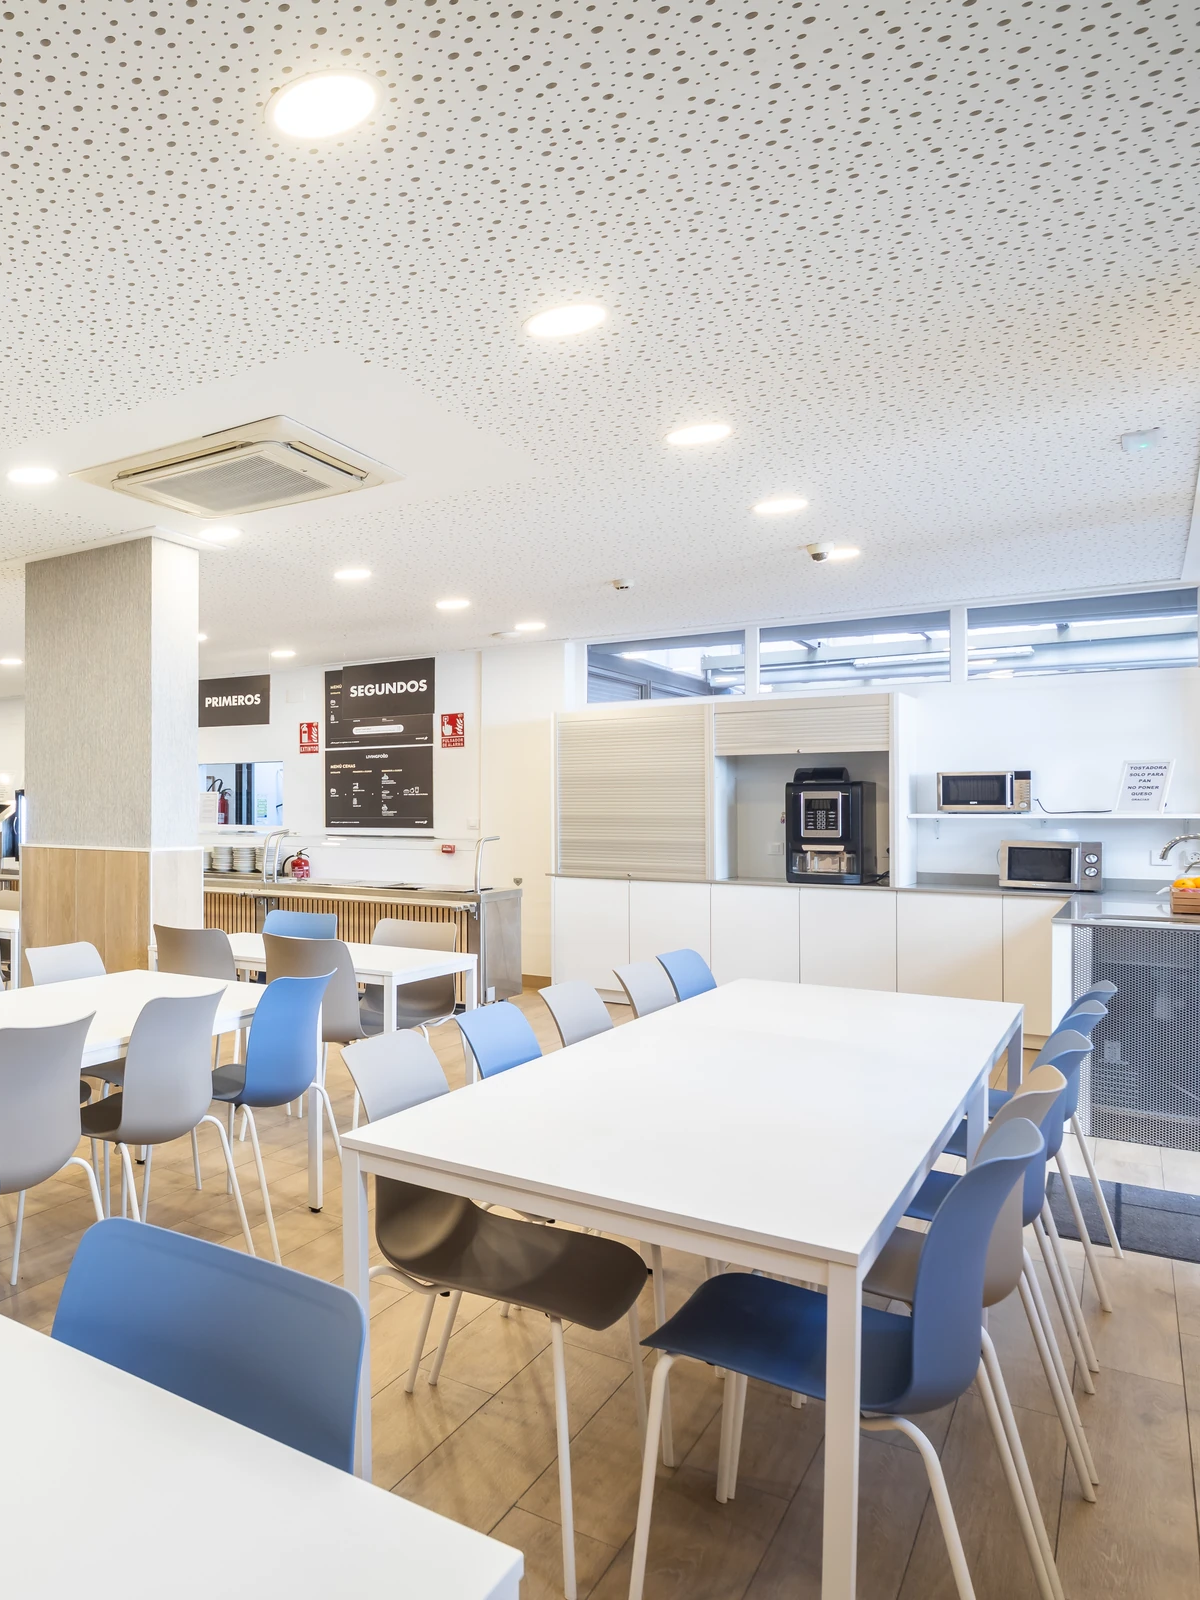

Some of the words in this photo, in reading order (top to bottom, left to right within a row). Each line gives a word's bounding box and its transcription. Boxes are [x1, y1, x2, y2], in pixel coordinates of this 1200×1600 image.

[349, 679, 428, 698] SEGUNDOS
[204, 693, 261, 708] PRIMEROS
[300, 744, 319, 753] EXTINTOR
